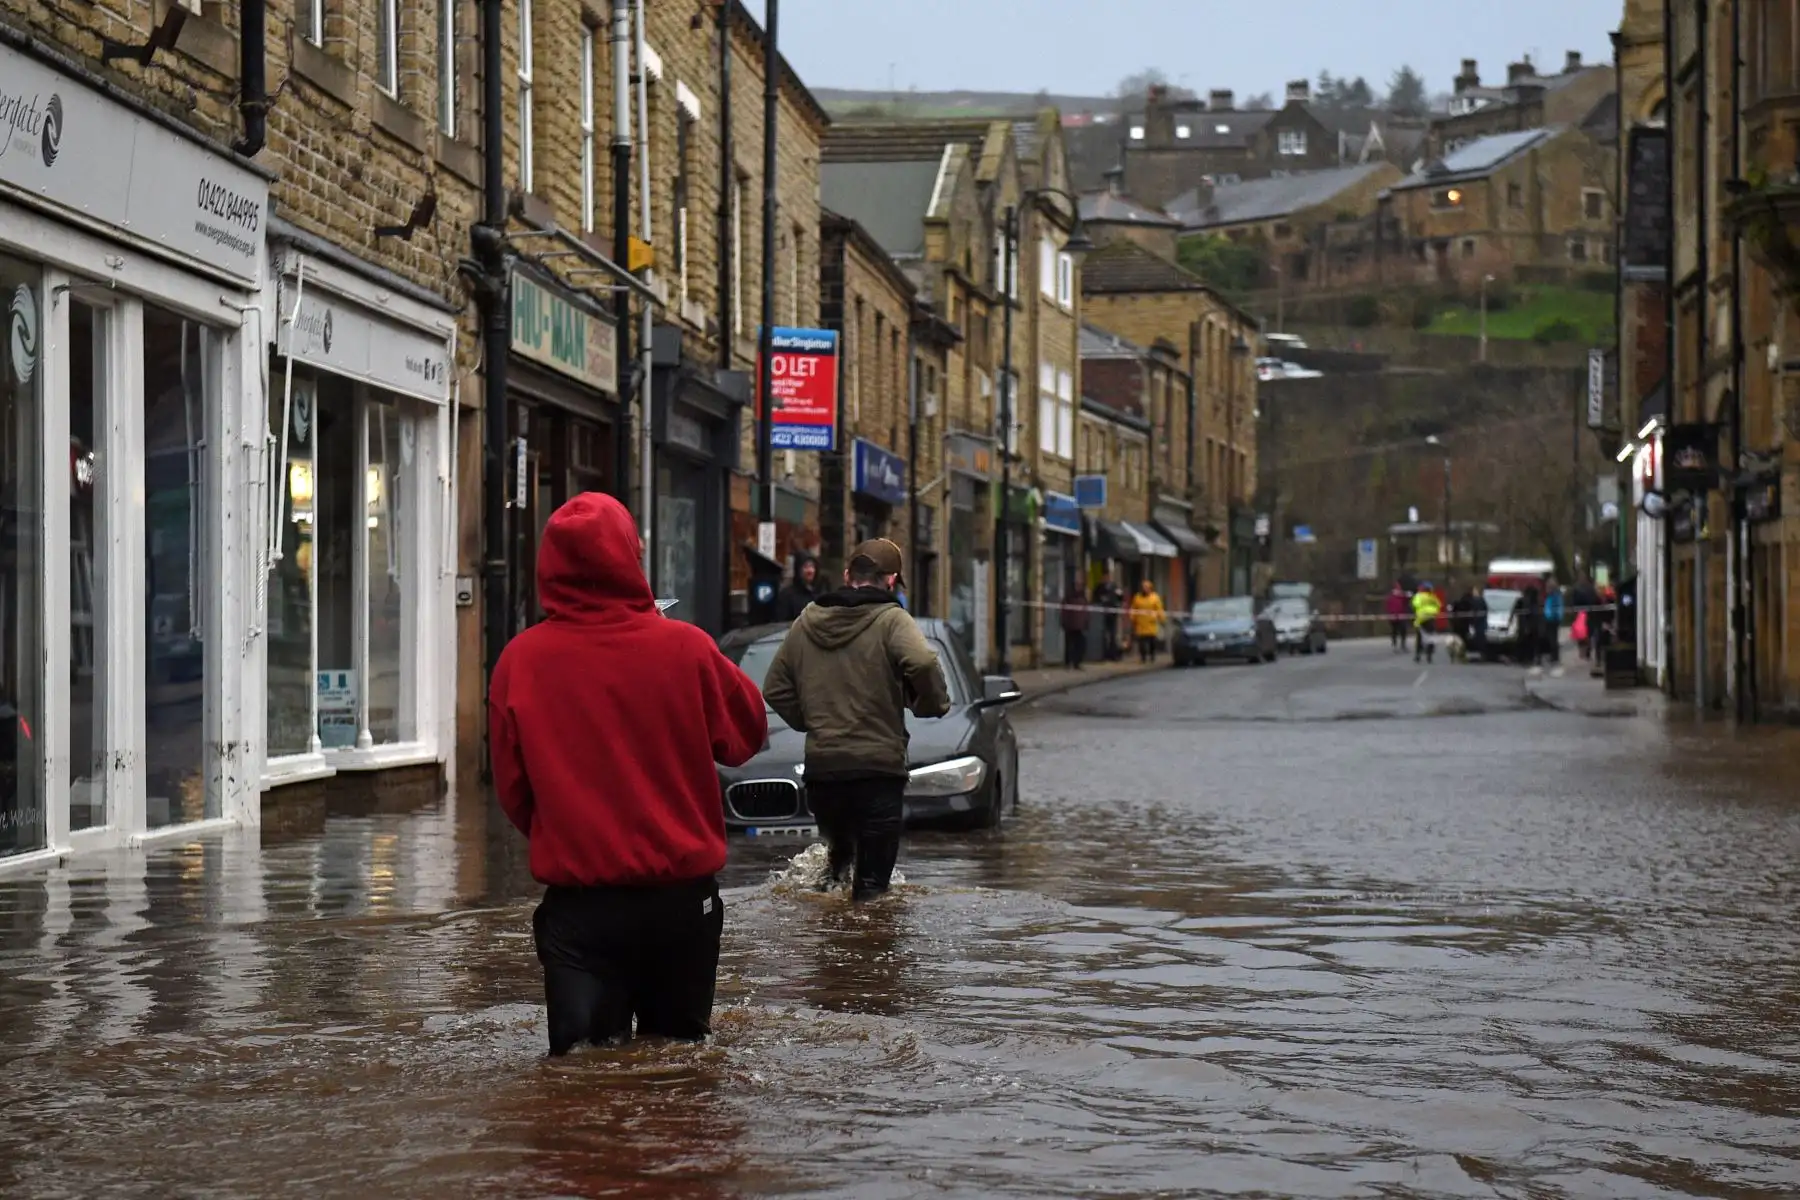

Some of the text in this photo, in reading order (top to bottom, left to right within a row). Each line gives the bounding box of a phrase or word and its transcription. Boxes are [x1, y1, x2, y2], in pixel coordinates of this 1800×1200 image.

[198, 177, 260, 233] 01422 844995
[770, 355, 821, 378] O LET
[758, 585, 772, 601] P
